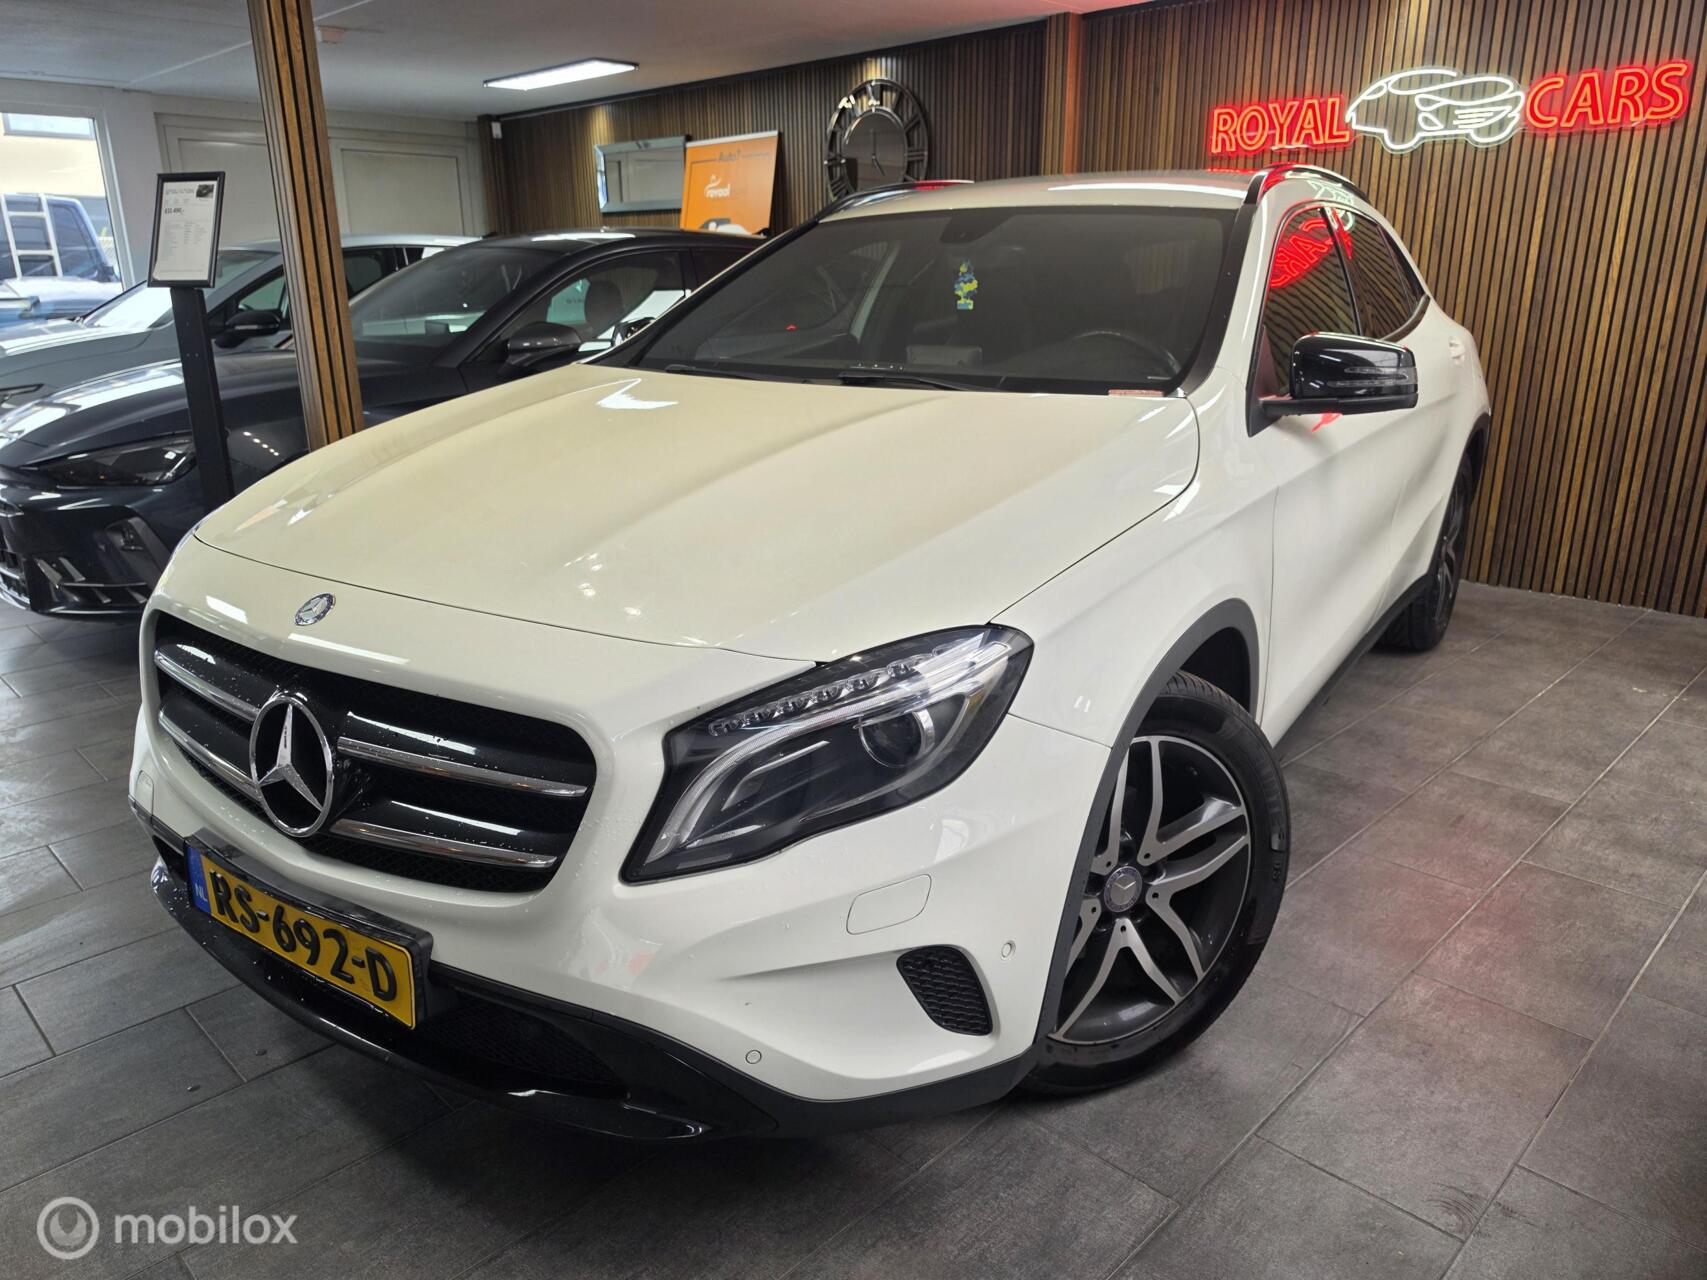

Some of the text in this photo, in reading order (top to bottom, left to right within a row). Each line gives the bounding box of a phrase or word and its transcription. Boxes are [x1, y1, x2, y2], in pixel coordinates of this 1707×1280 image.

[1211, 63, 1687, 153] ROYAL CARS
[195, 884, 207, 902] NL
[209, 870, 398, 1002] RS-692-D
